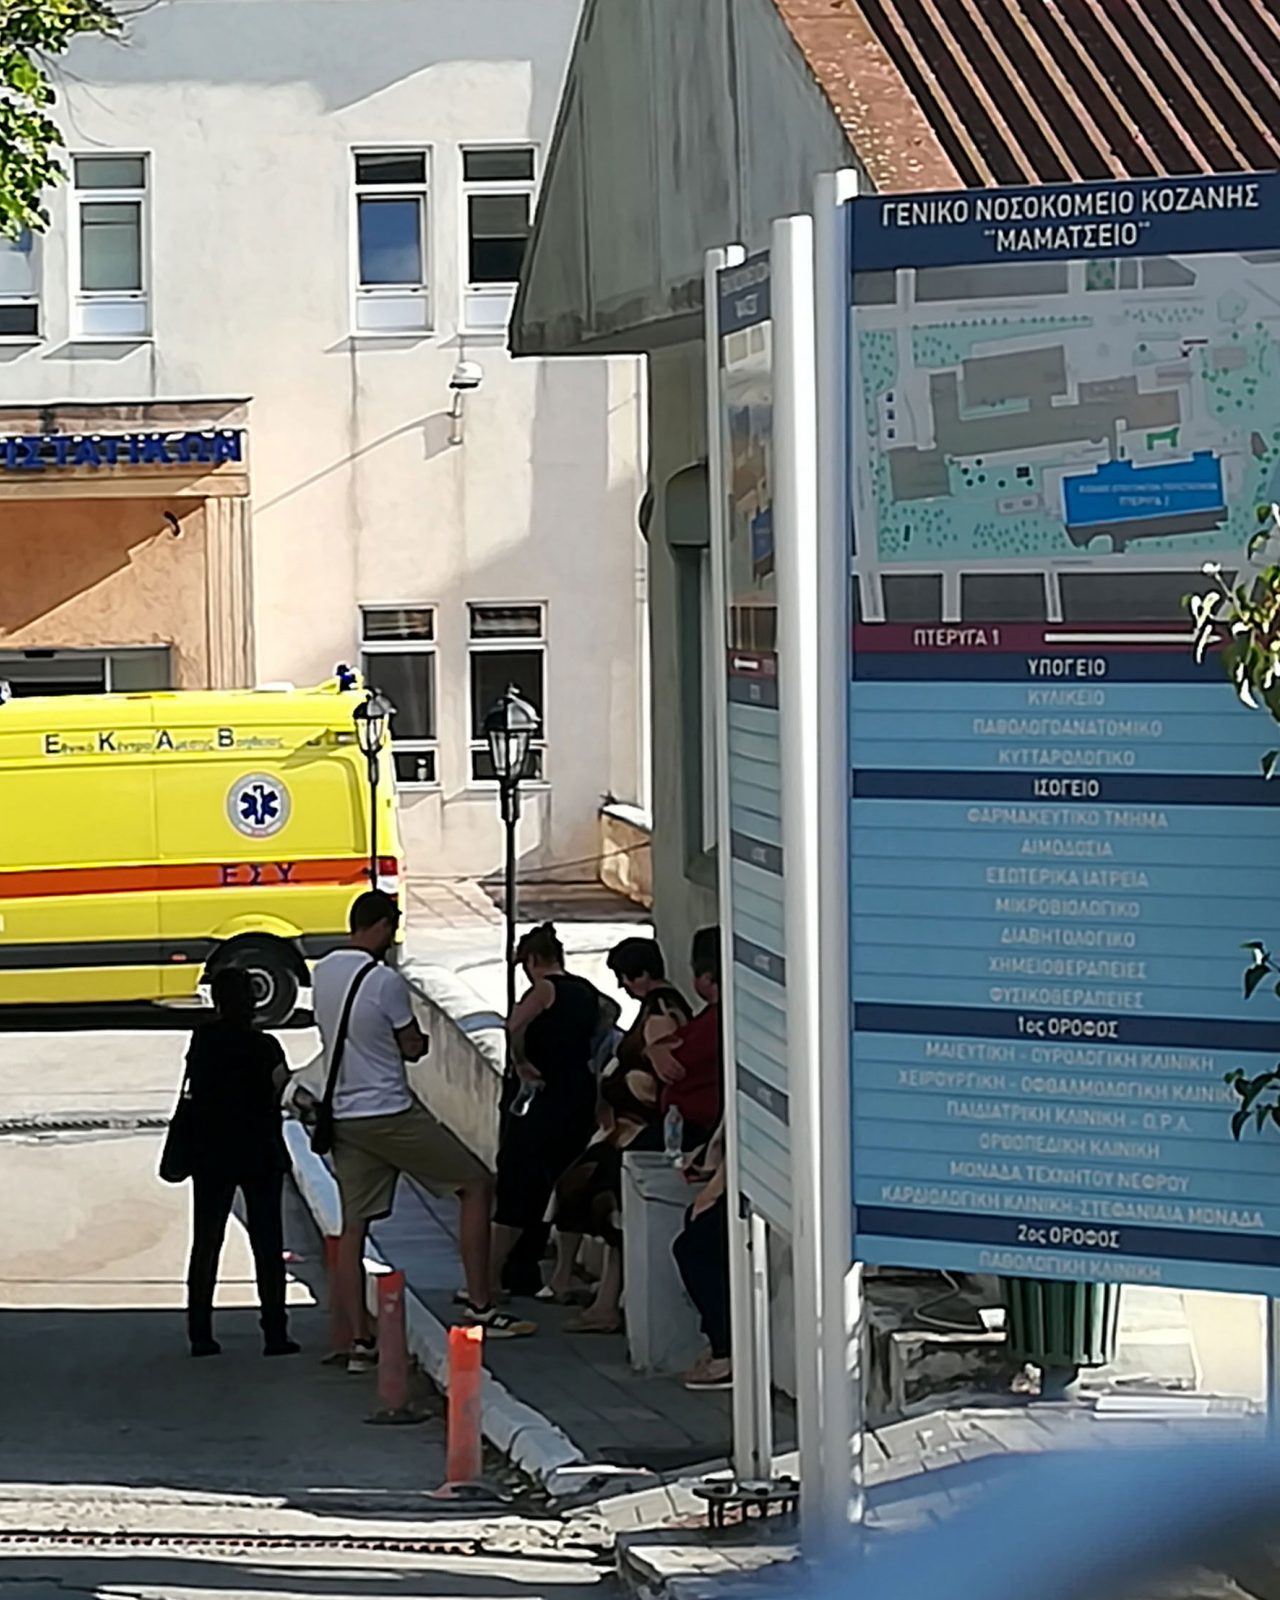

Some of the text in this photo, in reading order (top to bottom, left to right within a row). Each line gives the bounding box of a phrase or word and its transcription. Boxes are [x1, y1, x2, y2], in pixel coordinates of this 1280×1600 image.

[881, 183, 1260, 227] ΓΕΝΙΚΟ ΝΟΣΟΚΟΜΕΙΟ ΚΟΖΑΝΗΣ
[913, 629, 1000, 647] ΠΤΕΡΥΓΑ 1
[1027, 658, 1107, 677] ΥΠΟΓΕΙΟ
[1027, 689, 1106, 707] ΚΥΛΙΚΕΙΟ
[972, 718, 1163, 738] ΠΑΘΟΛΟΓΟΑΝΑΤΟΜΙΚΟ
[998, 749, 1135, 767] ΚΥΤΤΑΡΟΛΟΓΙΚΟ
[1033, 778, 1100, 798] ΙΣΟΓΕΙΟ
[966, 807, 1169, 828] ΦΑΡΜΑΚΕΥΤΙΚΟ ΤΜΗΜΑ
[1020, 838, 1114, 857] ΑΙΜΟΔΟΣΙΑ
[985, 866, 1149, 888] ΕΞΩΤΕΡΙΚΑ ΙΑΤΡΕΙΑ
[995, 897, 1140, 918] ΜΙΚΡΟΒΙΟΛΟΓΙΚΟ
[1000, 927, 1136, 948] ΔΙΑΒΗΤΟΛΟΓΙΚΟ
[989, 956, 1147, 979] ΧΗΜΕΙΟΘΕΡΑΠΕΙΕΣ
[989, 986, 1144, 1009] ΦΥΣΙΚΟΘΕΡΑΠΕΙΕΣ
[1018, 1016, 1119, 1039] 1ος ΟΡΟΦΟΣ
[925, 1040, 1016, 1062] ΜΑΙΕΥΤΙΚΗ
[1031, 1046, 1137, 1068] ΟΥΡΟΛΟΓΙΚΗ
[1141, 1053, 1214, 1072] ΚΛΙΝΙΚΗ
[898, 1069, 1007, 1090] ΧΕΙΡΟΥΡΓΙΚΗ
[1022, 1076, 1169, 1099] ΟΦΘΑΛΜΟΛΟΓΙΚΗ
[946, 1100, 1051, 1122] ΠΑΙΔΙΑΤΡΙΚΗ
[1055, 1107, 1126, 1127] ΚΛΙΝΙΚΗ
[979, 1133, 1161, 1159] ΟΡΘΟΠΕΔΙΚΗ ΚΛΙΝΙΚΗ
[950, 1161, 1190, 1192] ΜΟΝΑΔΑ ΤΕΧΝΗΤΟΥ ΝΕΦΡΟΥ
[881, 1185, 1000, 1209] ΚΑΡΔΙΟΛΟΓΙΚΗ
[1187, 1207, 1265, 1228] ΜΟΝΑΔΑ
[1017, 1224, 1121, 1249] 2ος ΟΡΟΦΟΣ
[979, 1251, 1162, 1280] ΠΑΘΟΛΟΓΙΚΗ ΚΛΙΝΙΚΗ
